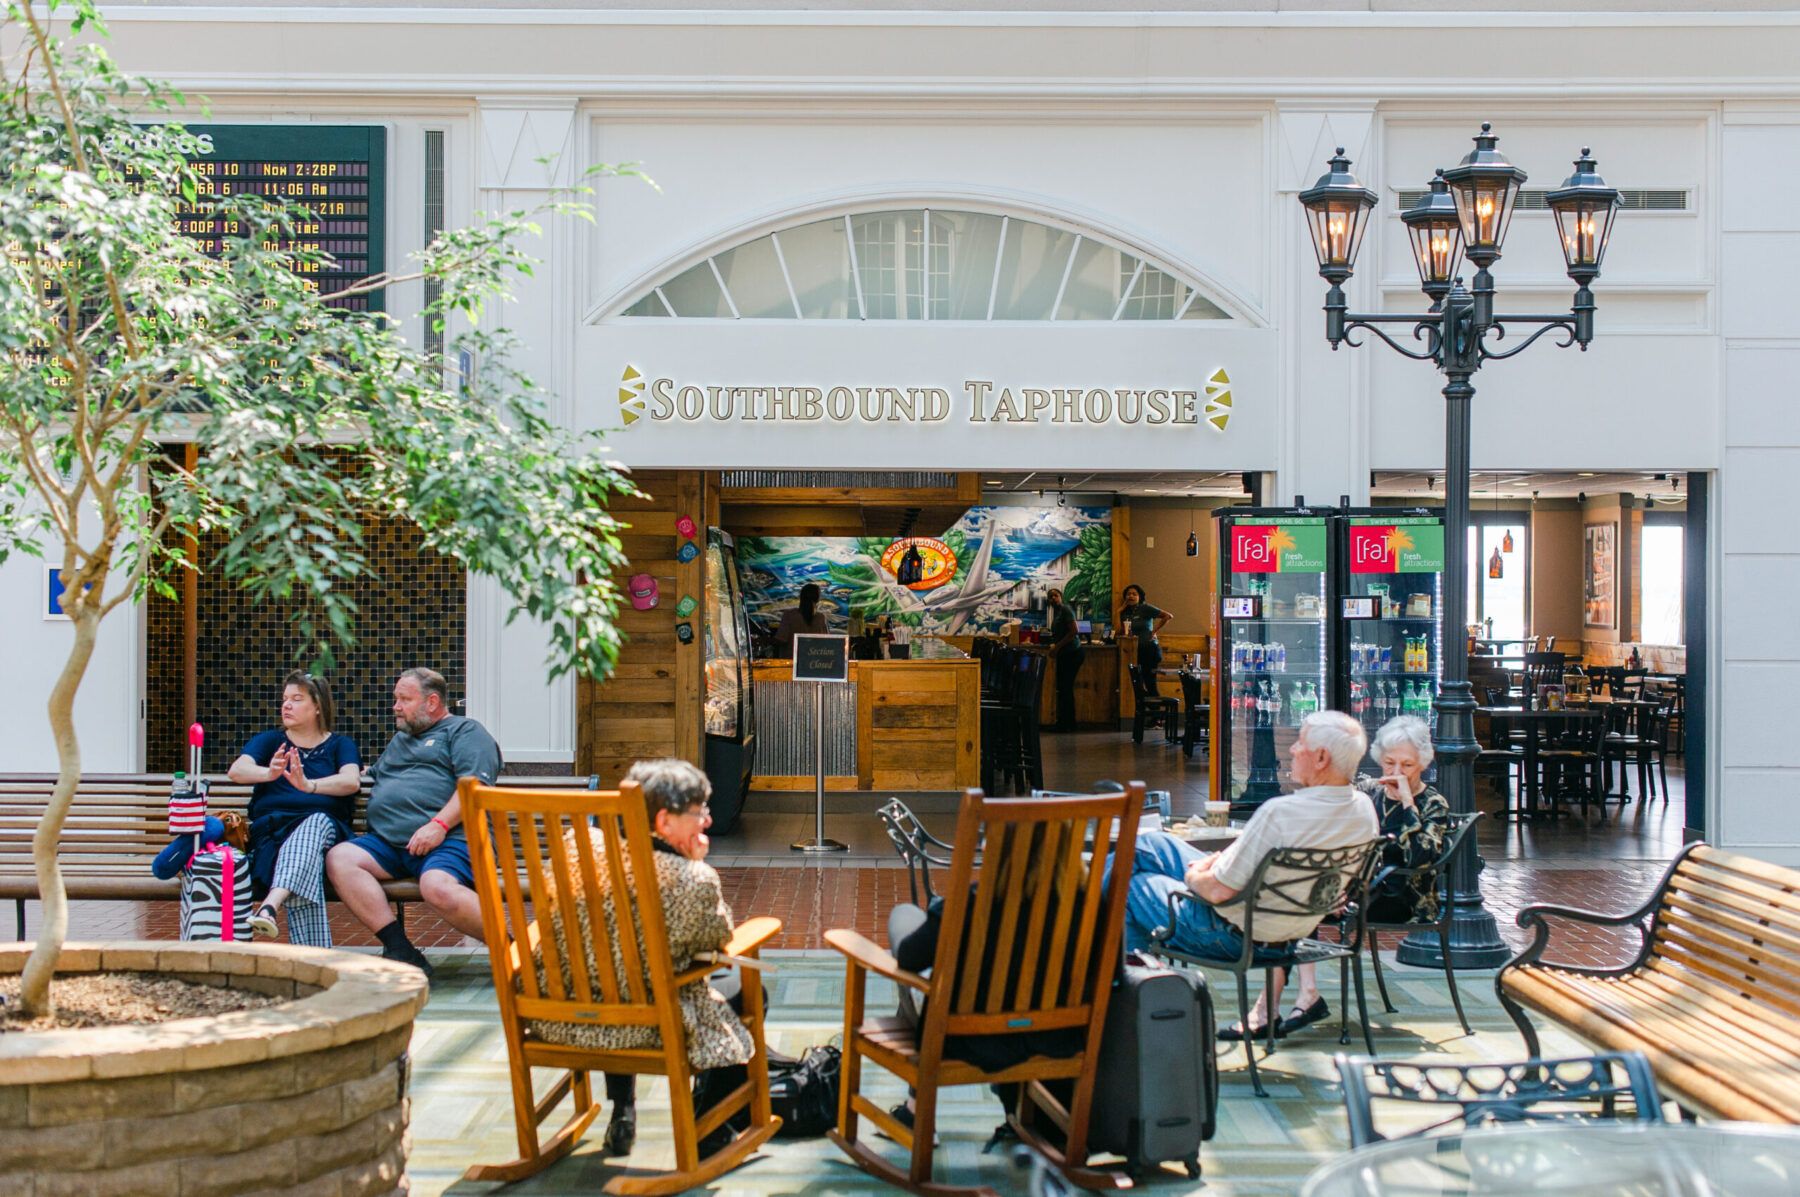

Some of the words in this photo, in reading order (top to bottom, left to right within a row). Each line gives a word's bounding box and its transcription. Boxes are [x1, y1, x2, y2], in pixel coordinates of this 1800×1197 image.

[224, 163, 239, 175] 10
[263, 163, 287, 175] Now
[296, 163, 336, 176] 2:28P
[264, 183, 304, 195] 11:06
[312, 183, 327, 195] Am
[224, 221, 239, 233] 13
[288, 221, 319, 234] Time
[263, 240, 279, 252] On
[288, 240, 319, 252] Time
[288, 259, 319, 272] Time
[650, 378, 951, 422] SOUTHBOUND
[964, 380, 1198, 424] TAPHOUSE
[808, 647, 835, 656] Section
[809, 660, 835, 669] Closed
